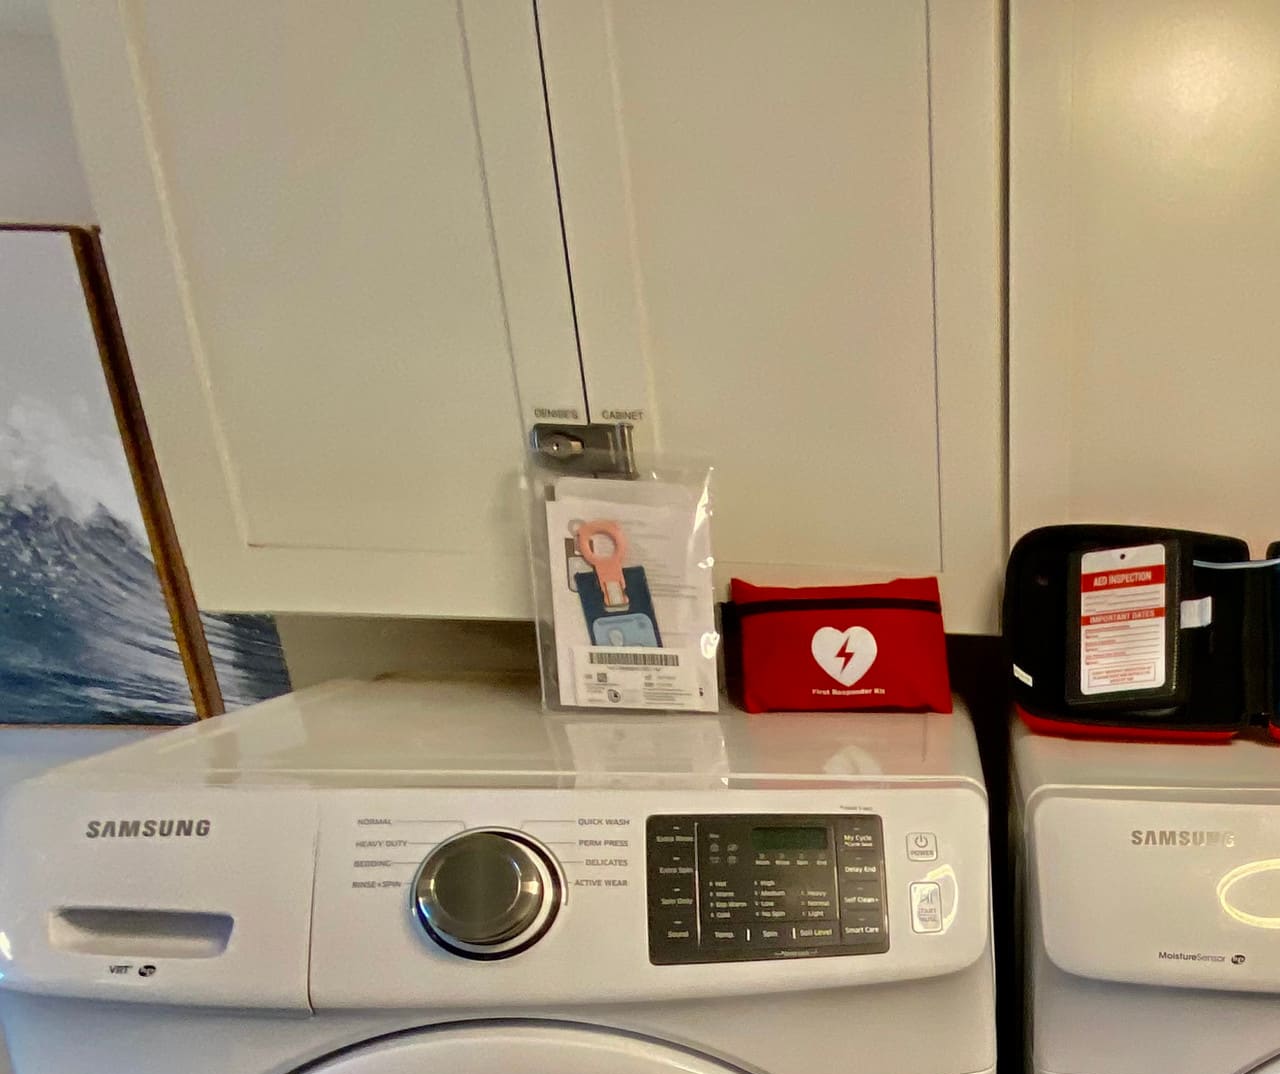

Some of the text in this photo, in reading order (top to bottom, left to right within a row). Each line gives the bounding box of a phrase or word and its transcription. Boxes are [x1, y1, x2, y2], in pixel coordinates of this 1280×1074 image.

[601, 409, 645, 421] CABINET
[1108, 571, 1153, 585] INSPECTION
[1090, 609, 1156, 624] IMPORTANT DATES
[578, 818, 604, 826] QUICK
[86, 820, 211, 839] SAMSUNG
[355, 840, 408, 848] HEAVY DUTY
[1131, 830, 1236, 848] SAMSUNG
[585, 859, 629, 867] DELICATES
[574, 879, 628, 887] ACTIVE WEAR
